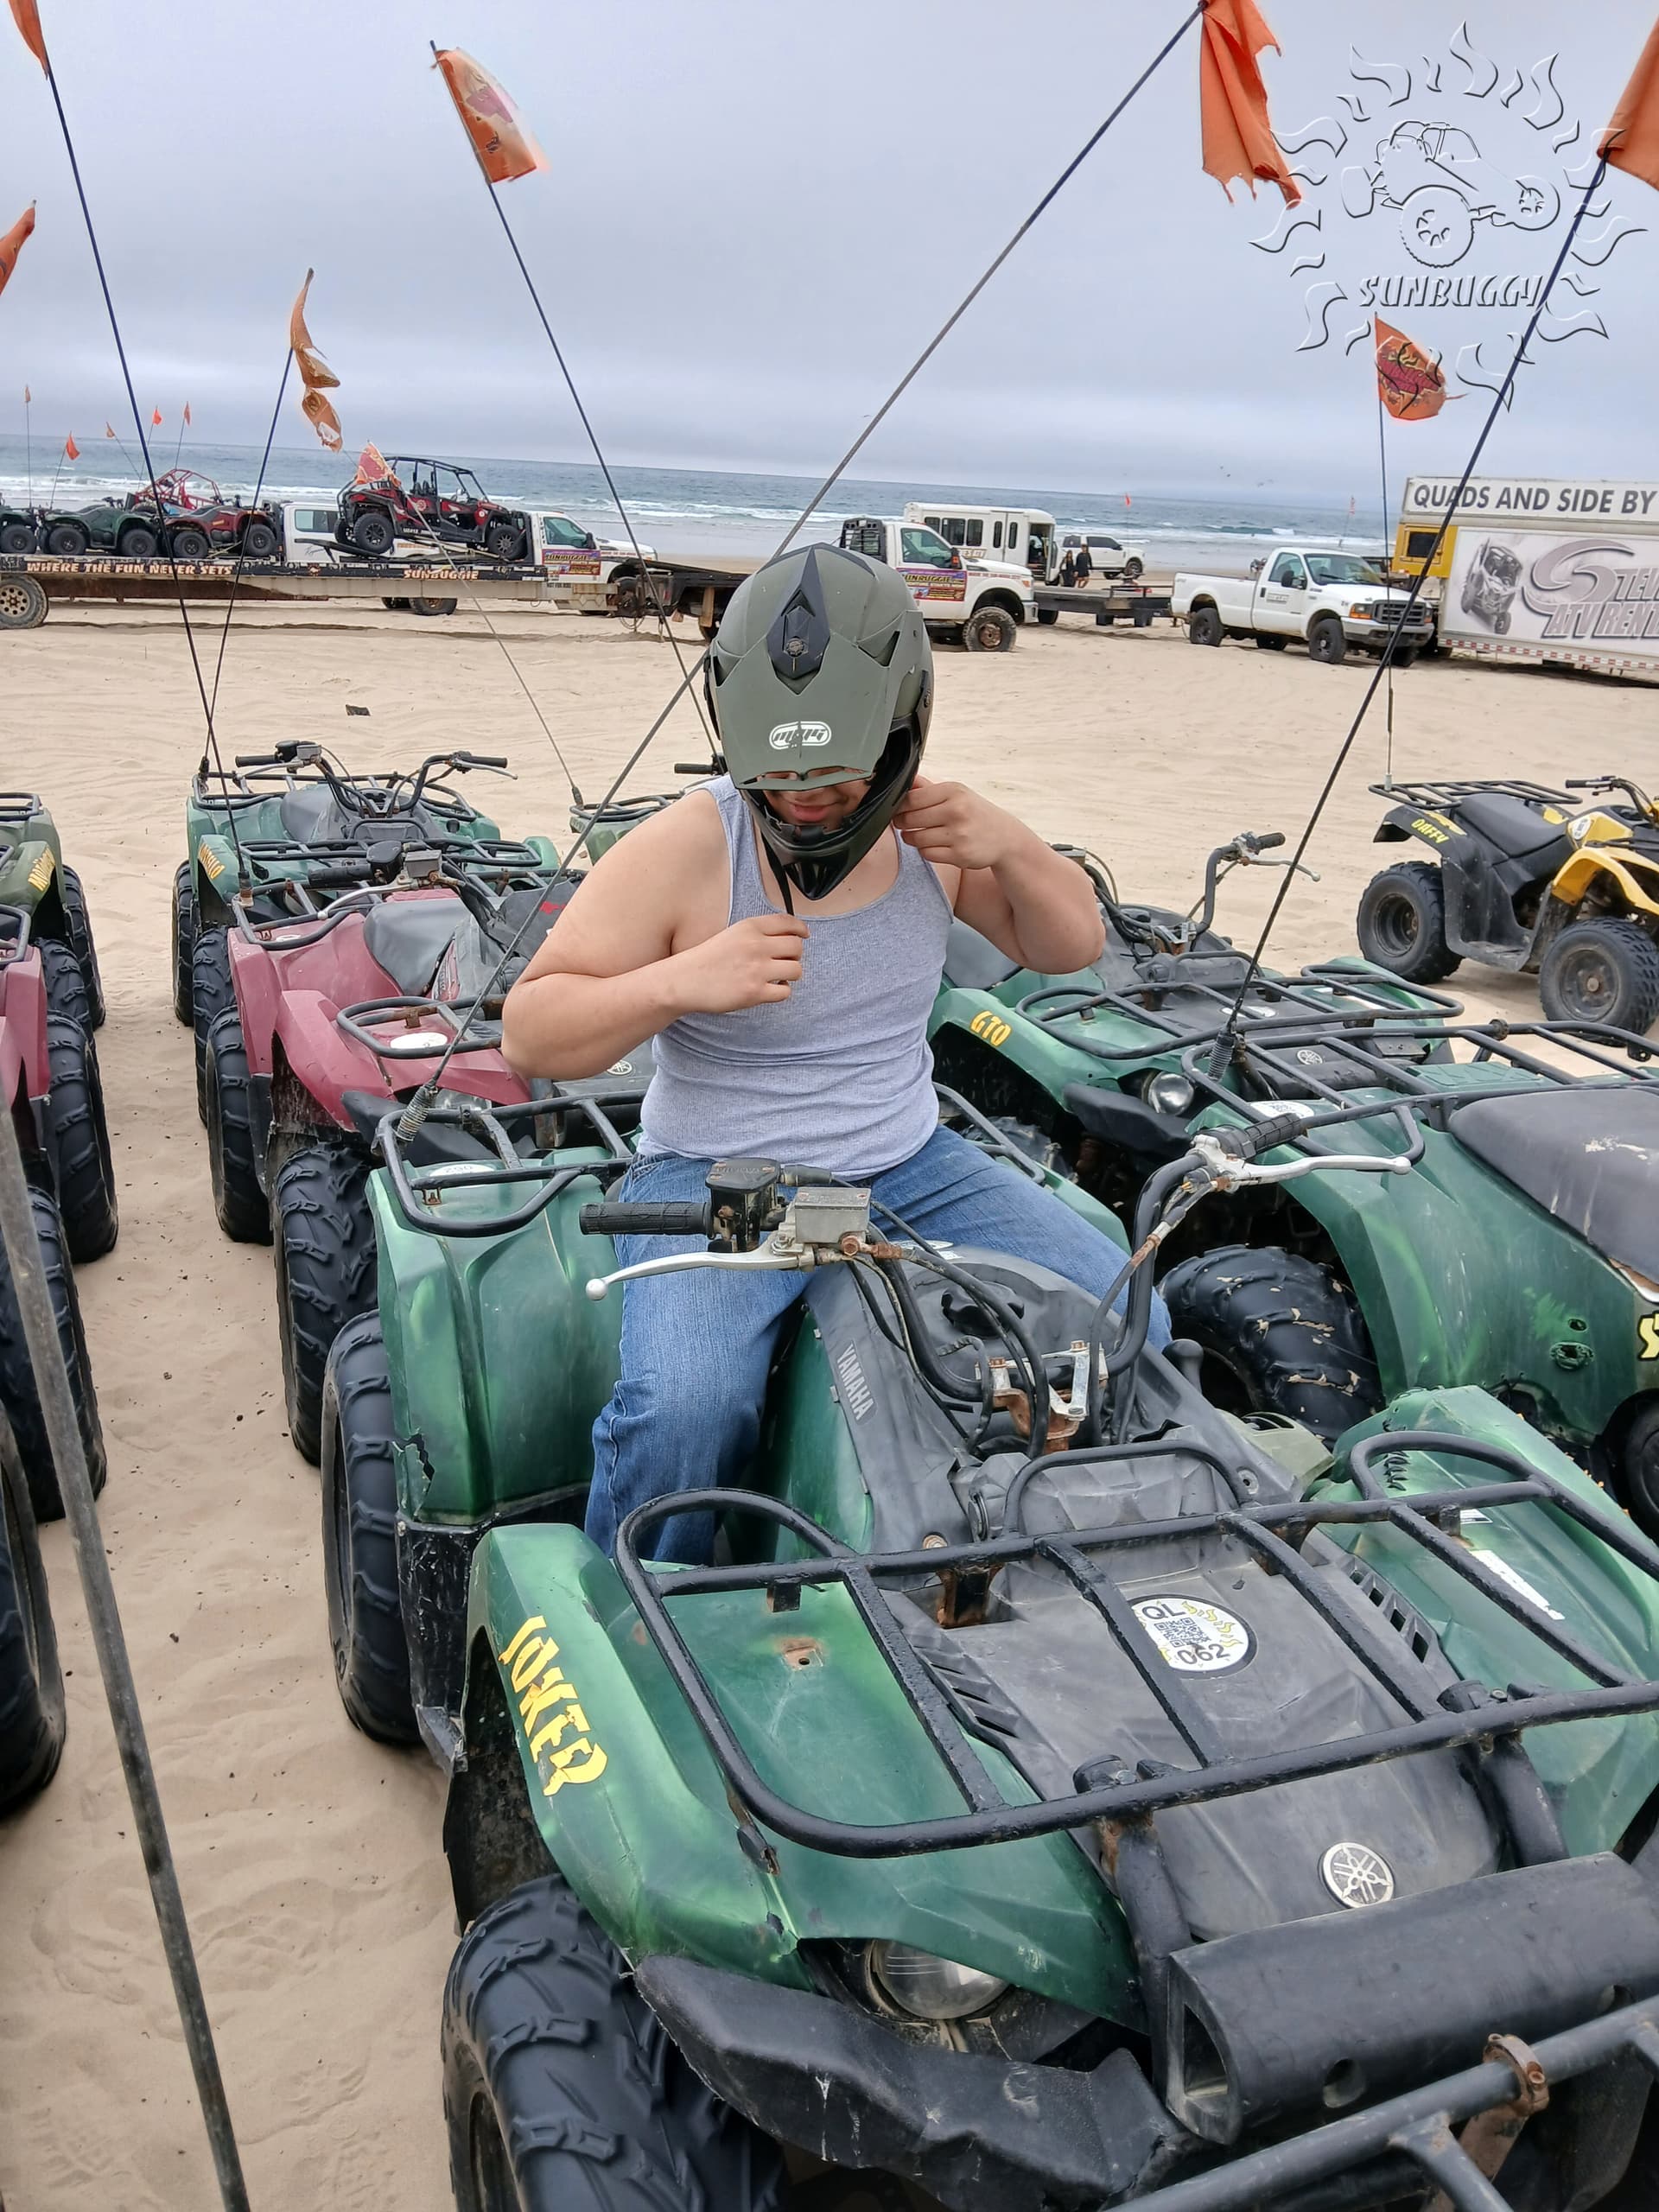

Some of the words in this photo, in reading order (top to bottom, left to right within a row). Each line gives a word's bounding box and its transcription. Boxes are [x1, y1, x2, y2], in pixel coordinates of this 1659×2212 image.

[1414, 484, 1491, 508] QUADS
[1496, 486, 1550, 511] AND
[1556, 488, 1615, 513] SIDE
[1621, 490, 1658, 515] BY
[27, 563, 79, 573] WHERE
[84, 563, 111, 573] THE
[114, 563, 145, 574] FUN
[149, 564, 196, 575] NEVER
[200, 565, 233, 575] SETS
[404, 569, 479, 580] SUNBUGGIE
[1541, 602, 1603, 639] ATV
[1410, 818, 1450, 844] DAFFY
[969, 1010, 1012, 1046] GTO
[836, 1342, 874, 1421] YAMAHA
[1141, 1602, 1186, 1620] QL
[1177, 1643, 1231, 1666] 062
[498, 1615, 608, 1797] JOKER
